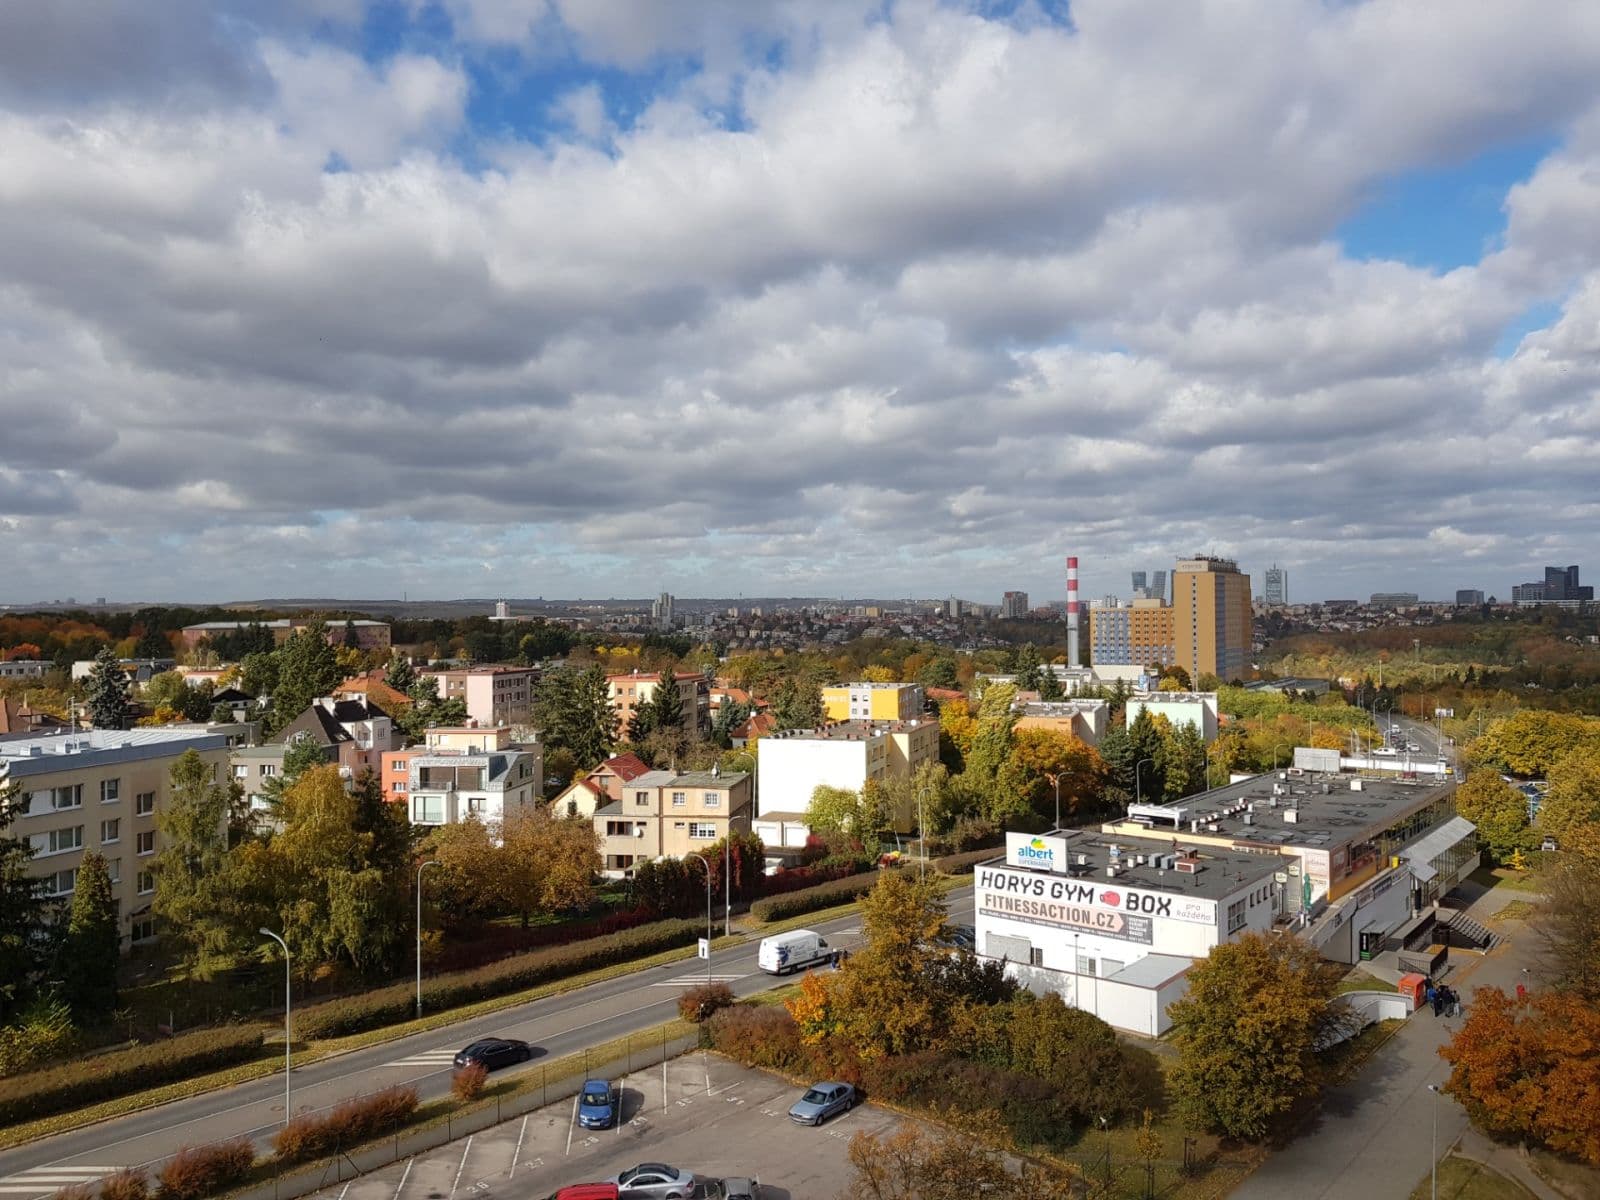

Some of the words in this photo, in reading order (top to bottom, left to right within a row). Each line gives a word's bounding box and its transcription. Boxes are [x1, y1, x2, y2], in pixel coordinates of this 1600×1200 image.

[1018, 846, 1053, 860] albert
[981, 871, 1045, 896] HORYS
[1051, 882, 1094, 904] GYM
[1126, 892, 1172, 917] BOX
[985, 893, 1115, 929] FITNESSACTION.CZ
